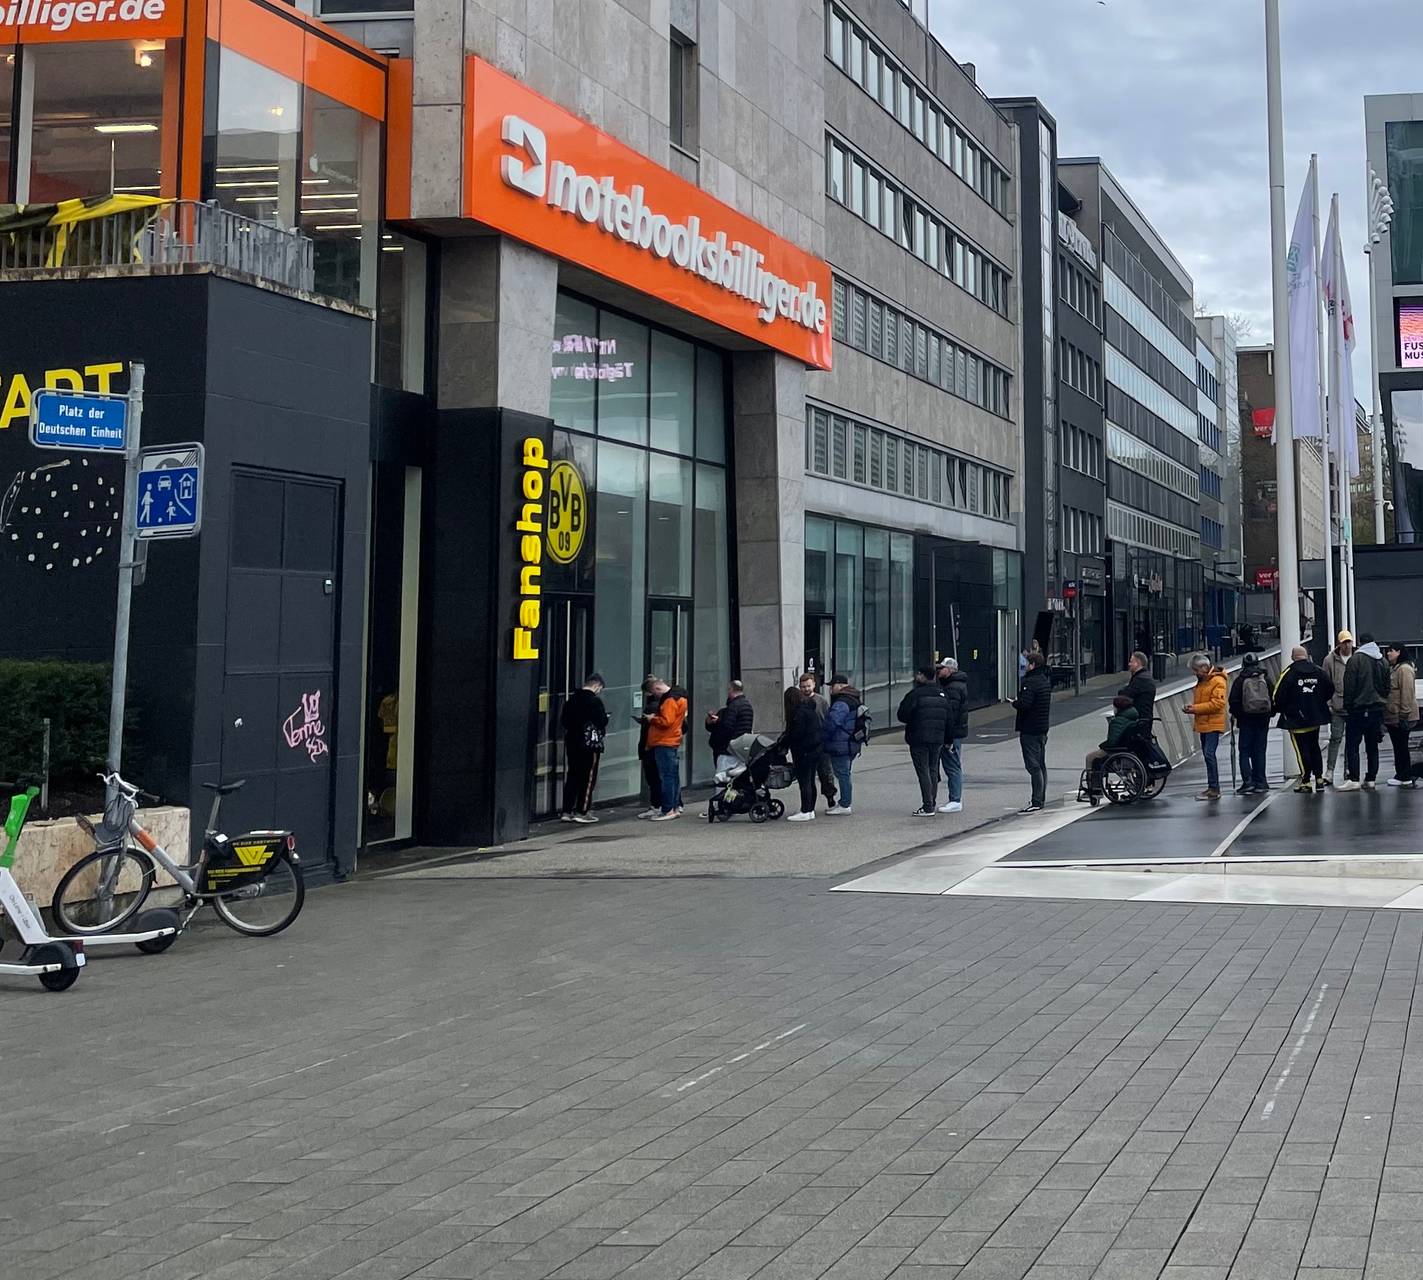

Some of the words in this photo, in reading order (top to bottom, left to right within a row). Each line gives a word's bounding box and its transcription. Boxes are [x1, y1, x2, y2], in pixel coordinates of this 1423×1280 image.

[547, 160, 826, 333] notebooksbilliger.de
[39, 422, 86, 436] Deutschen
[91, 426, 122, 439] Einheit
[59, 405, 83, 418] Platz
[88, 407, 105, 419] der
[550, 471, 581, 532] BVB
[514, 438, 548, 659] Fanshop
[558, 531, 571, 551] 09
